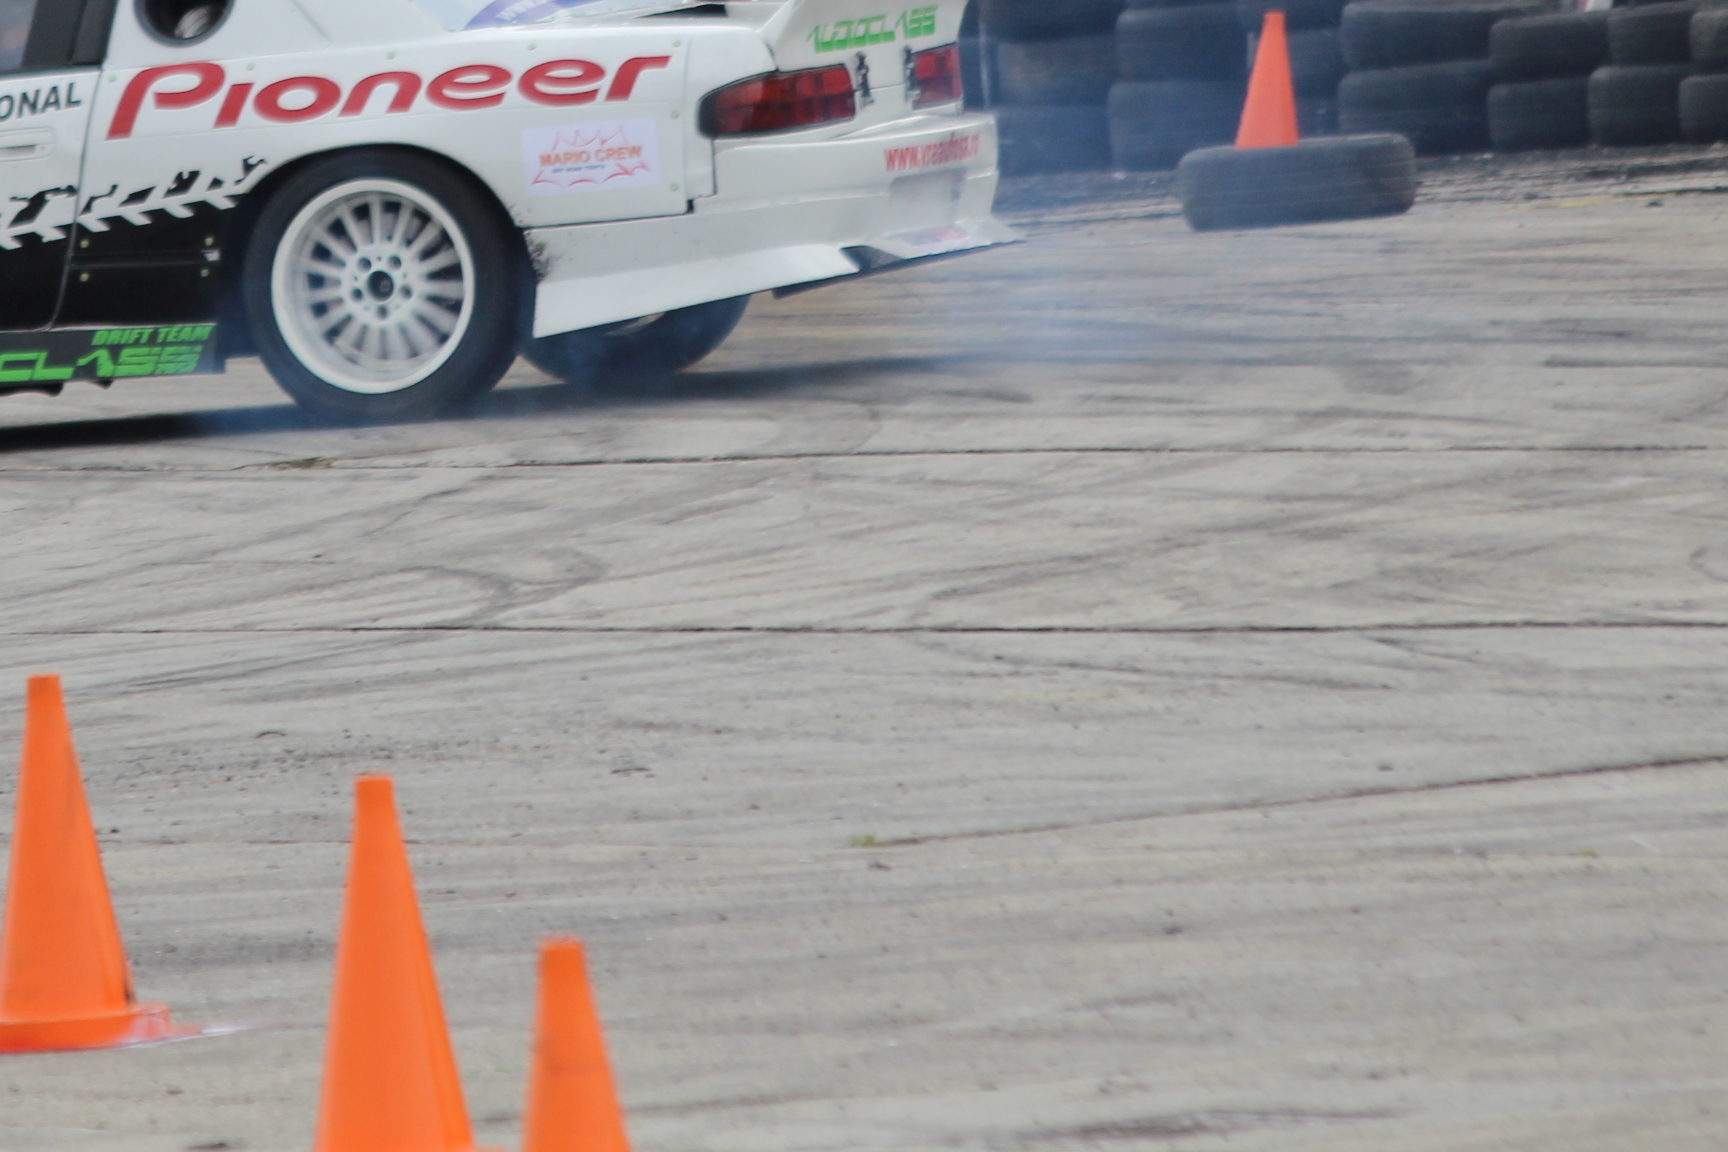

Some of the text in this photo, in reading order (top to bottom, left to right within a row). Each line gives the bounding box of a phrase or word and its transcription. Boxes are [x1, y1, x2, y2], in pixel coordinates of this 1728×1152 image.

[106, 55, 672, 141] Pioneer
[539, 145, 643, 167] MARIO CREW
[92, 325, 215, 347] DRIFT TEAM
